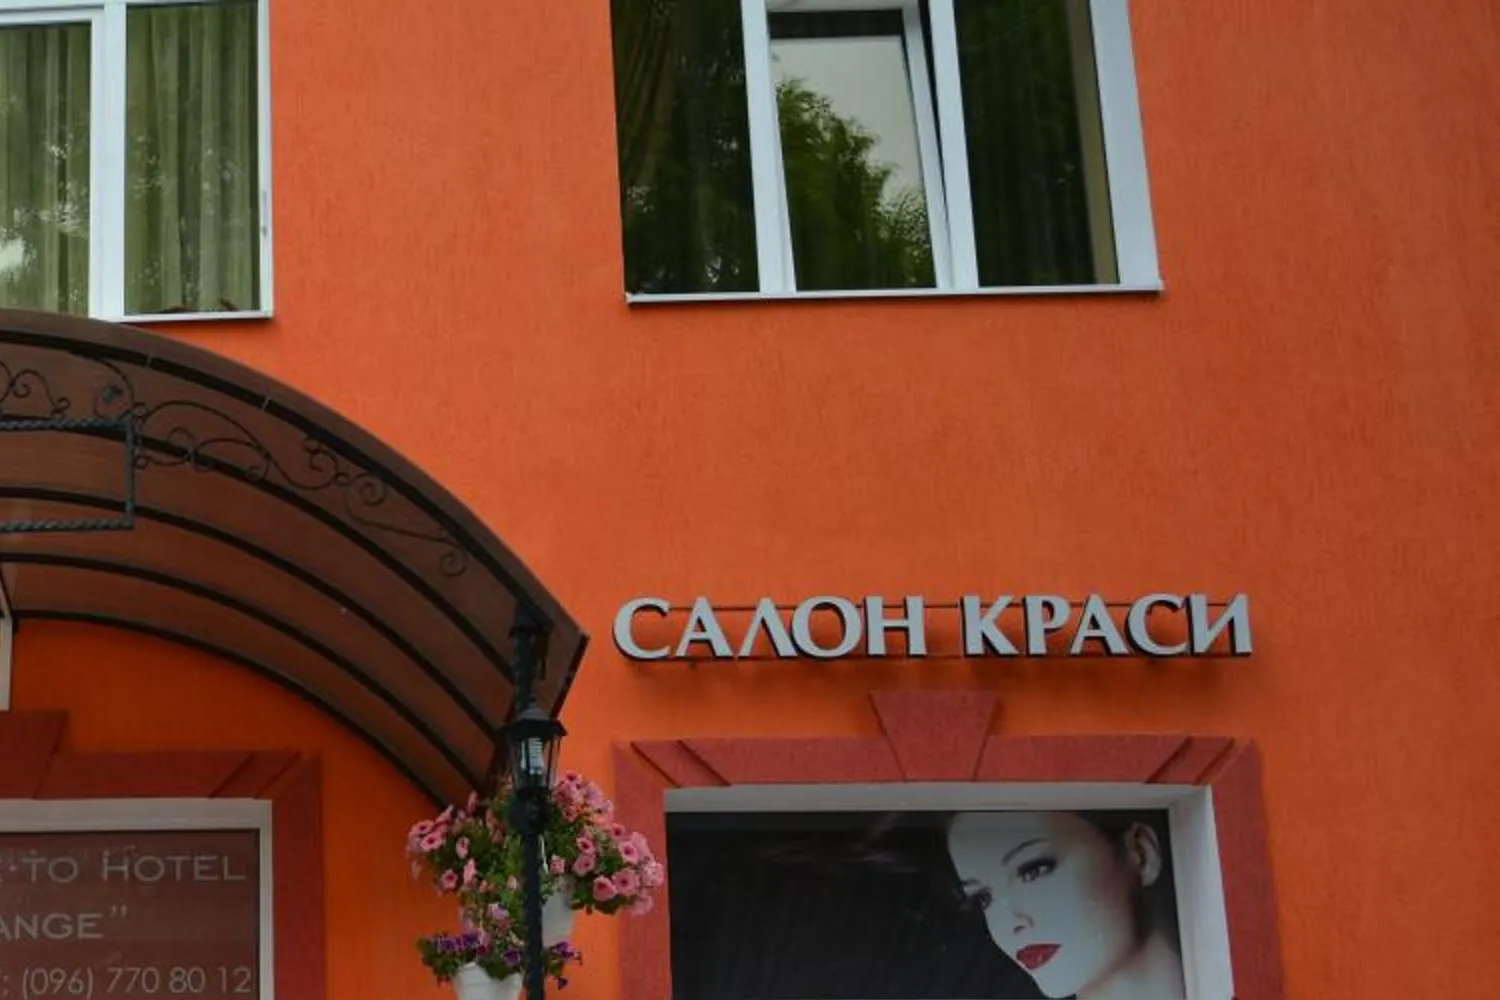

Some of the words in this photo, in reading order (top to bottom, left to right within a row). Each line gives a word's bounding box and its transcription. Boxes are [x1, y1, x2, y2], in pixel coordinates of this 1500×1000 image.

[613, 595, 928, 660] САЛОН
[960, 593, 1252, 659] КРАСИ
[22, 856, 79, 883] TO
[102, 855, 247, 883] HOTEL
[22, 967, 94, 1000] (096)
[107, 966, 160, 994] 770
[169, 966, 206, 994] 80
[218, 966, 251, 993] 12
